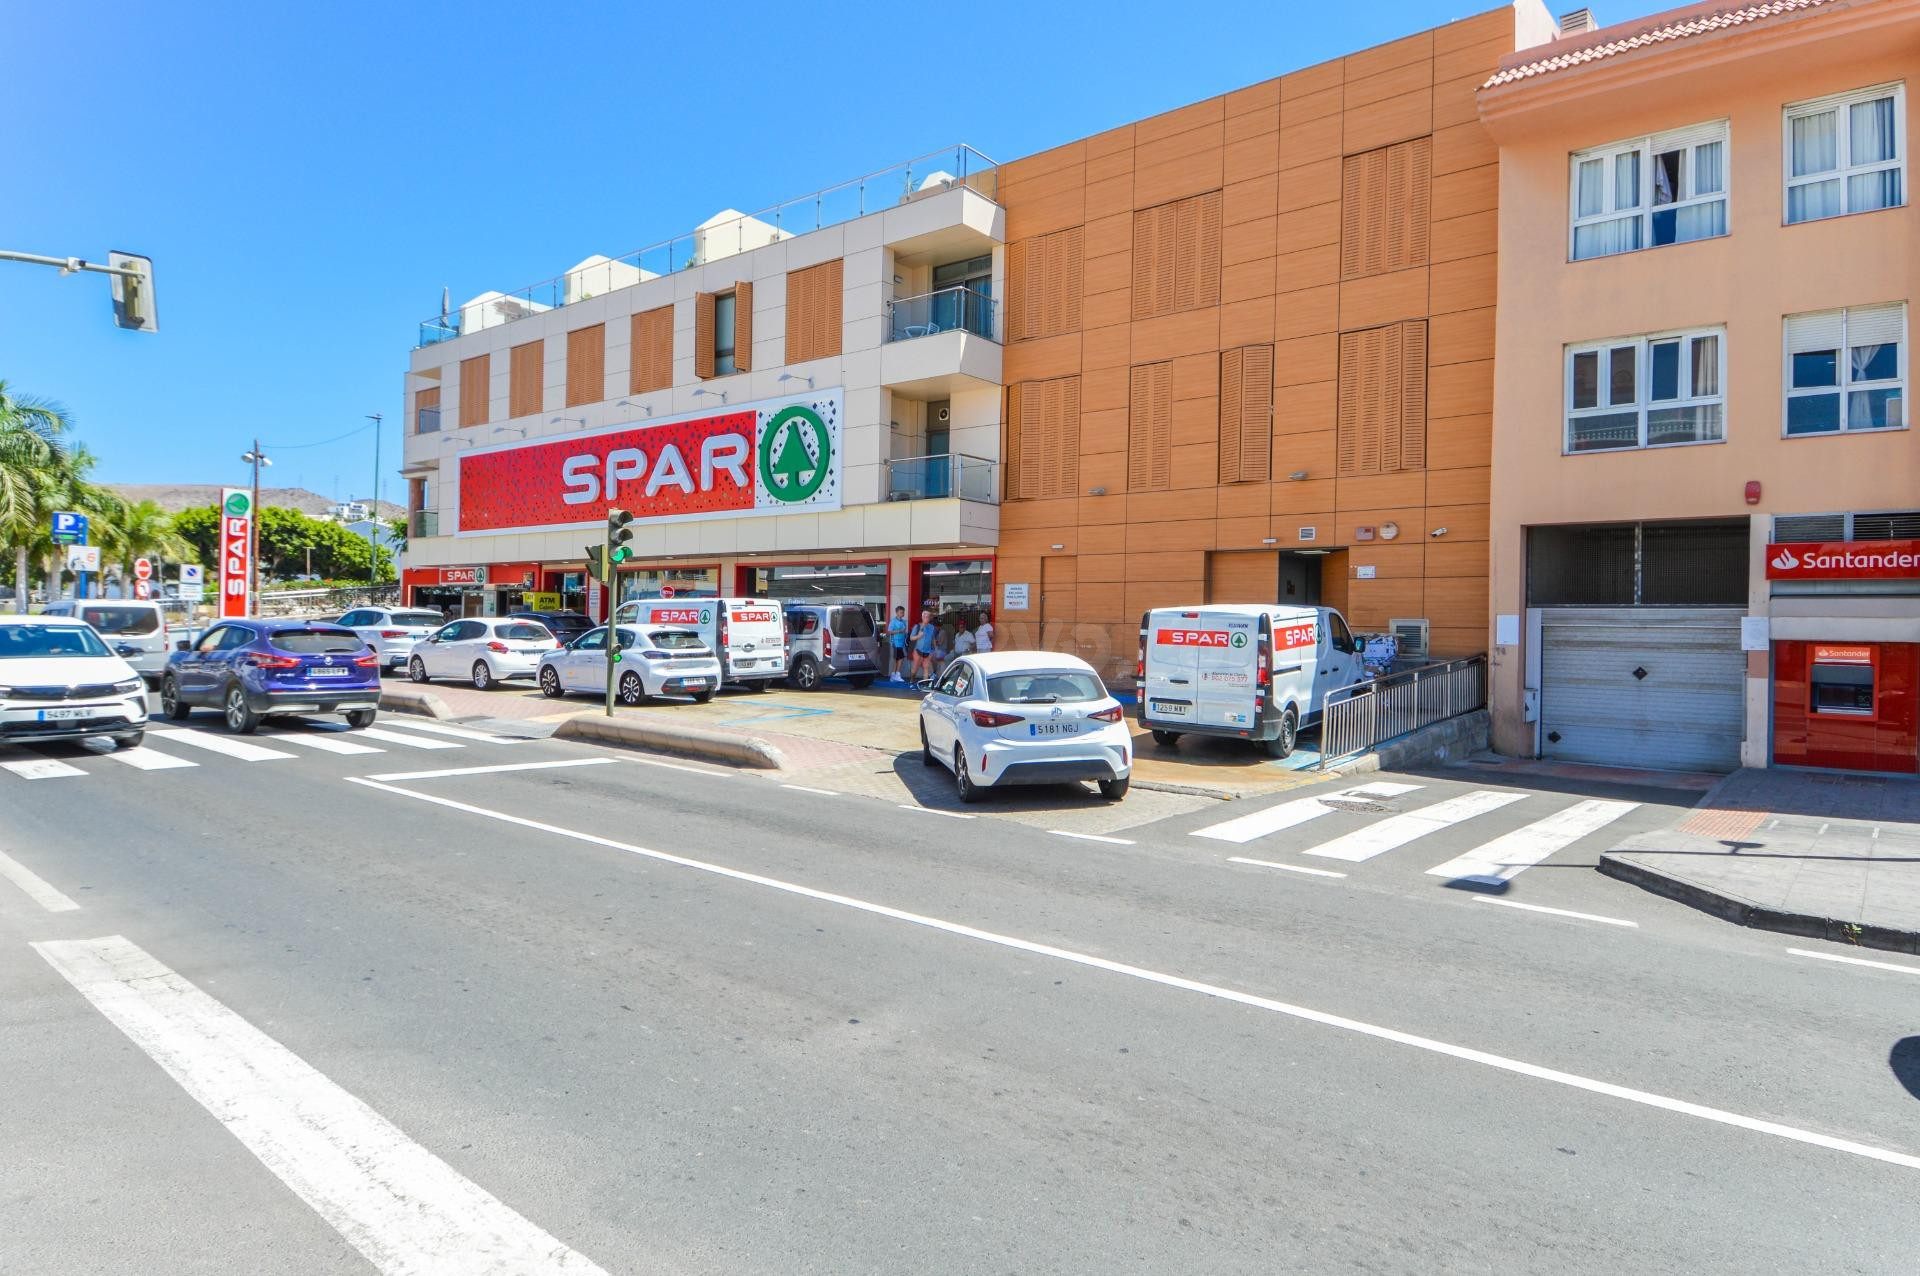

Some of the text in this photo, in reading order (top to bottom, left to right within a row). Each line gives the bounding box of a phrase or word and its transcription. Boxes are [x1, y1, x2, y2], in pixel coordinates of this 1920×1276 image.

[562, 432, 750, 505] SPAR
[58, 514, 76, 530] P
[227, 518, 247, 596] SPAR
[1802, 551, 1920, 569] Santander
[447, 571, 475, 581] SPAR
[660, 611, 698, 621] SPAR
[740, 613, 770, 621] SPAR
[1171, 631, 1228, 645] SPAR
[1285, 627, 1315, 646] SPAR
[1829, 649, 1870, 657] Santander
[47, 710, 71, 719] 5497
[1038, 723, 1079, 734] 5181 NGJ
